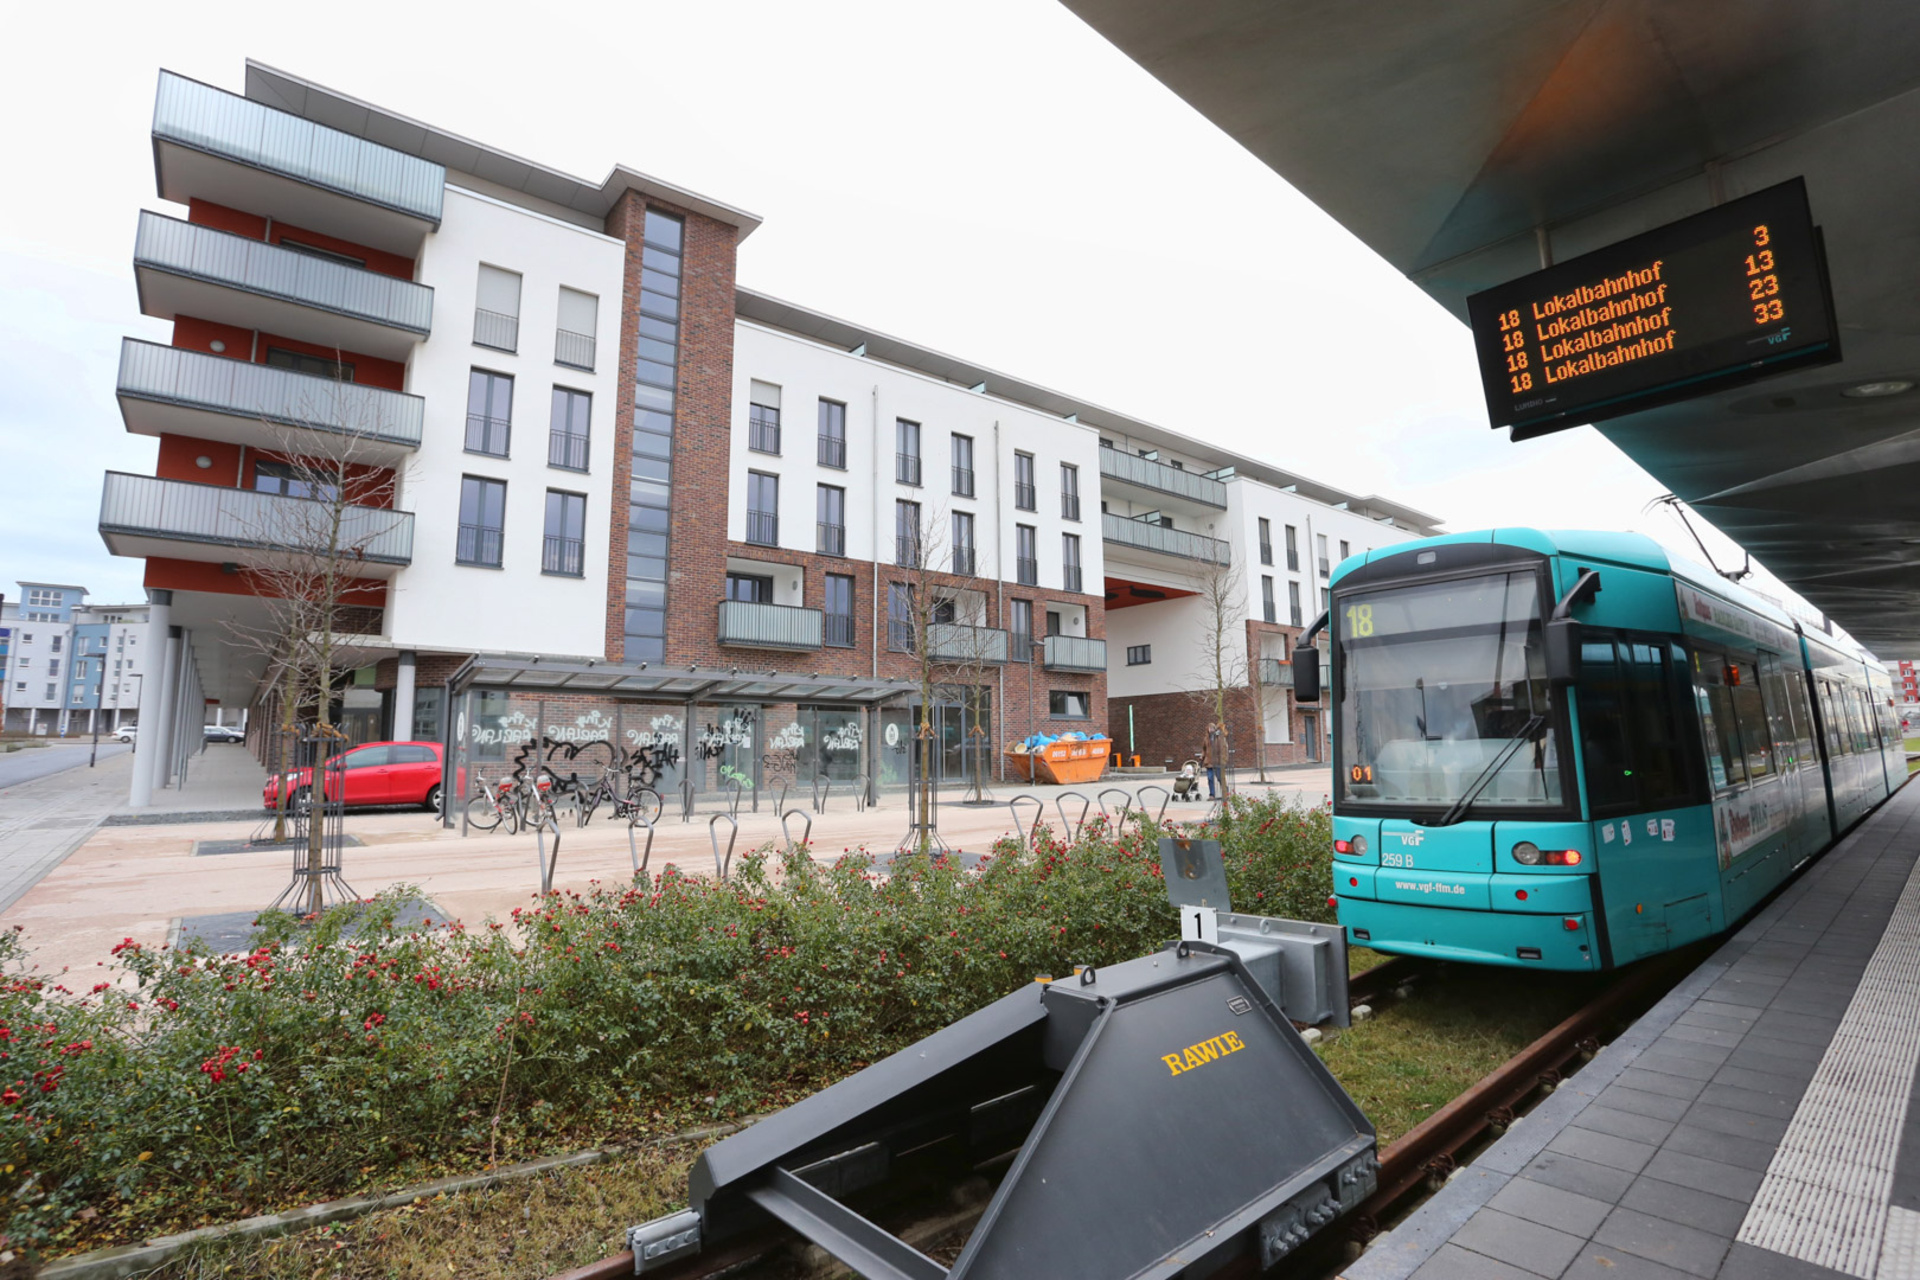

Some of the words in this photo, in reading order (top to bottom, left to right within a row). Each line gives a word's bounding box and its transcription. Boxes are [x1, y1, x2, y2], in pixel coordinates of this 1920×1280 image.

[1499, 309, 1520, 331] 18
[1532, 260, 1663, 320] Lokalbahnhof
[1753, 224, 1770, 247] 3
[1503, 330, 1524, 352] 18
[1536, 283, 1667, 341] Lokalbahnhof
[1744, 249, 1774, 276] 13
[1507, 351, 1528, 373] 18
[1541, 306, 1672, 362] Lokalbahnhof
[1749, 274, 1779, 300] 23
[1767, 327, 1791, 345] VGF
[1511, 372, 1533, 393] 18
[1545, 329, 1676, 383] Lokalbahnhof
[1753, 299, 1784, 324] 33
[1346, 604, 1373, 638] 18
[1352, 766, 1372, 782] 01
[1401, 829, 1424, 846] VGF
[1382, 852, 1403, 867] 259
[1405, 854, 1414, 868] B
[1395, 881, 1465, 895] www.vgf-ffm.de
[1194, 912, 1203, 940] 1
[1161, 1030, 1246, 1077] RAWIE
